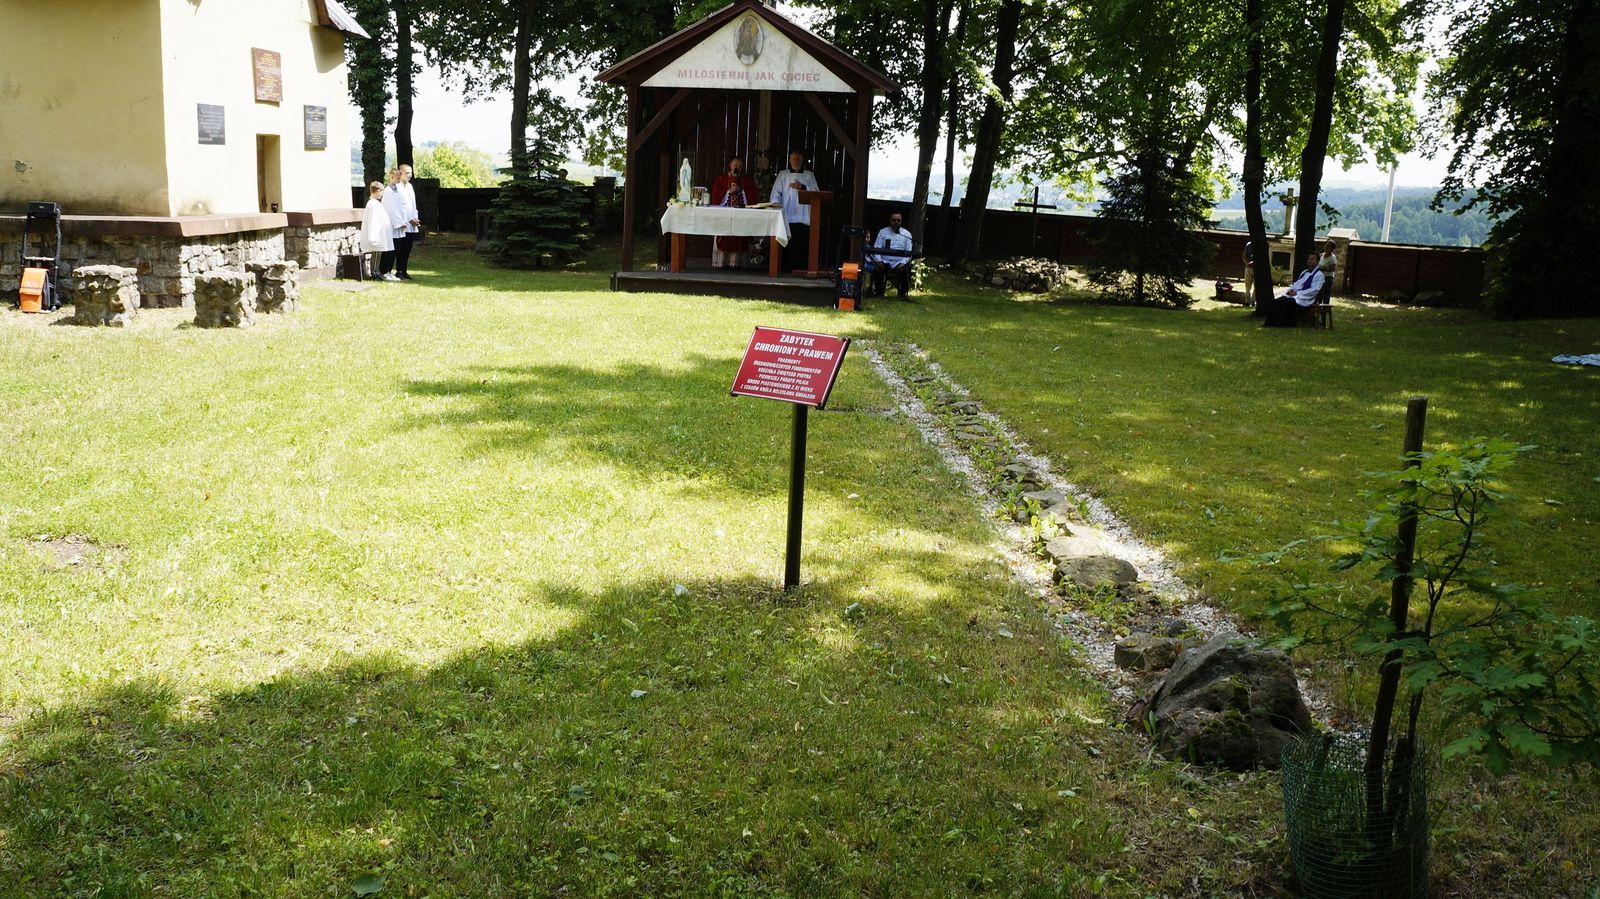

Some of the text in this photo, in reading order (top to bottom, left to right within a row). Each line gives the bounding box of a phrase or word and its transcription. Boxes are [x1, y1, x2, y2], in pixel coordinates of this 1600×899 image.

[678, 70, 749, 80] MIŁOSIERNI
[754, 72, 774, 81] JAK
[780, 334, 814, 346] ZABYTEK
[754, 342, 834, 360] CHRONIONY PRAWEM
